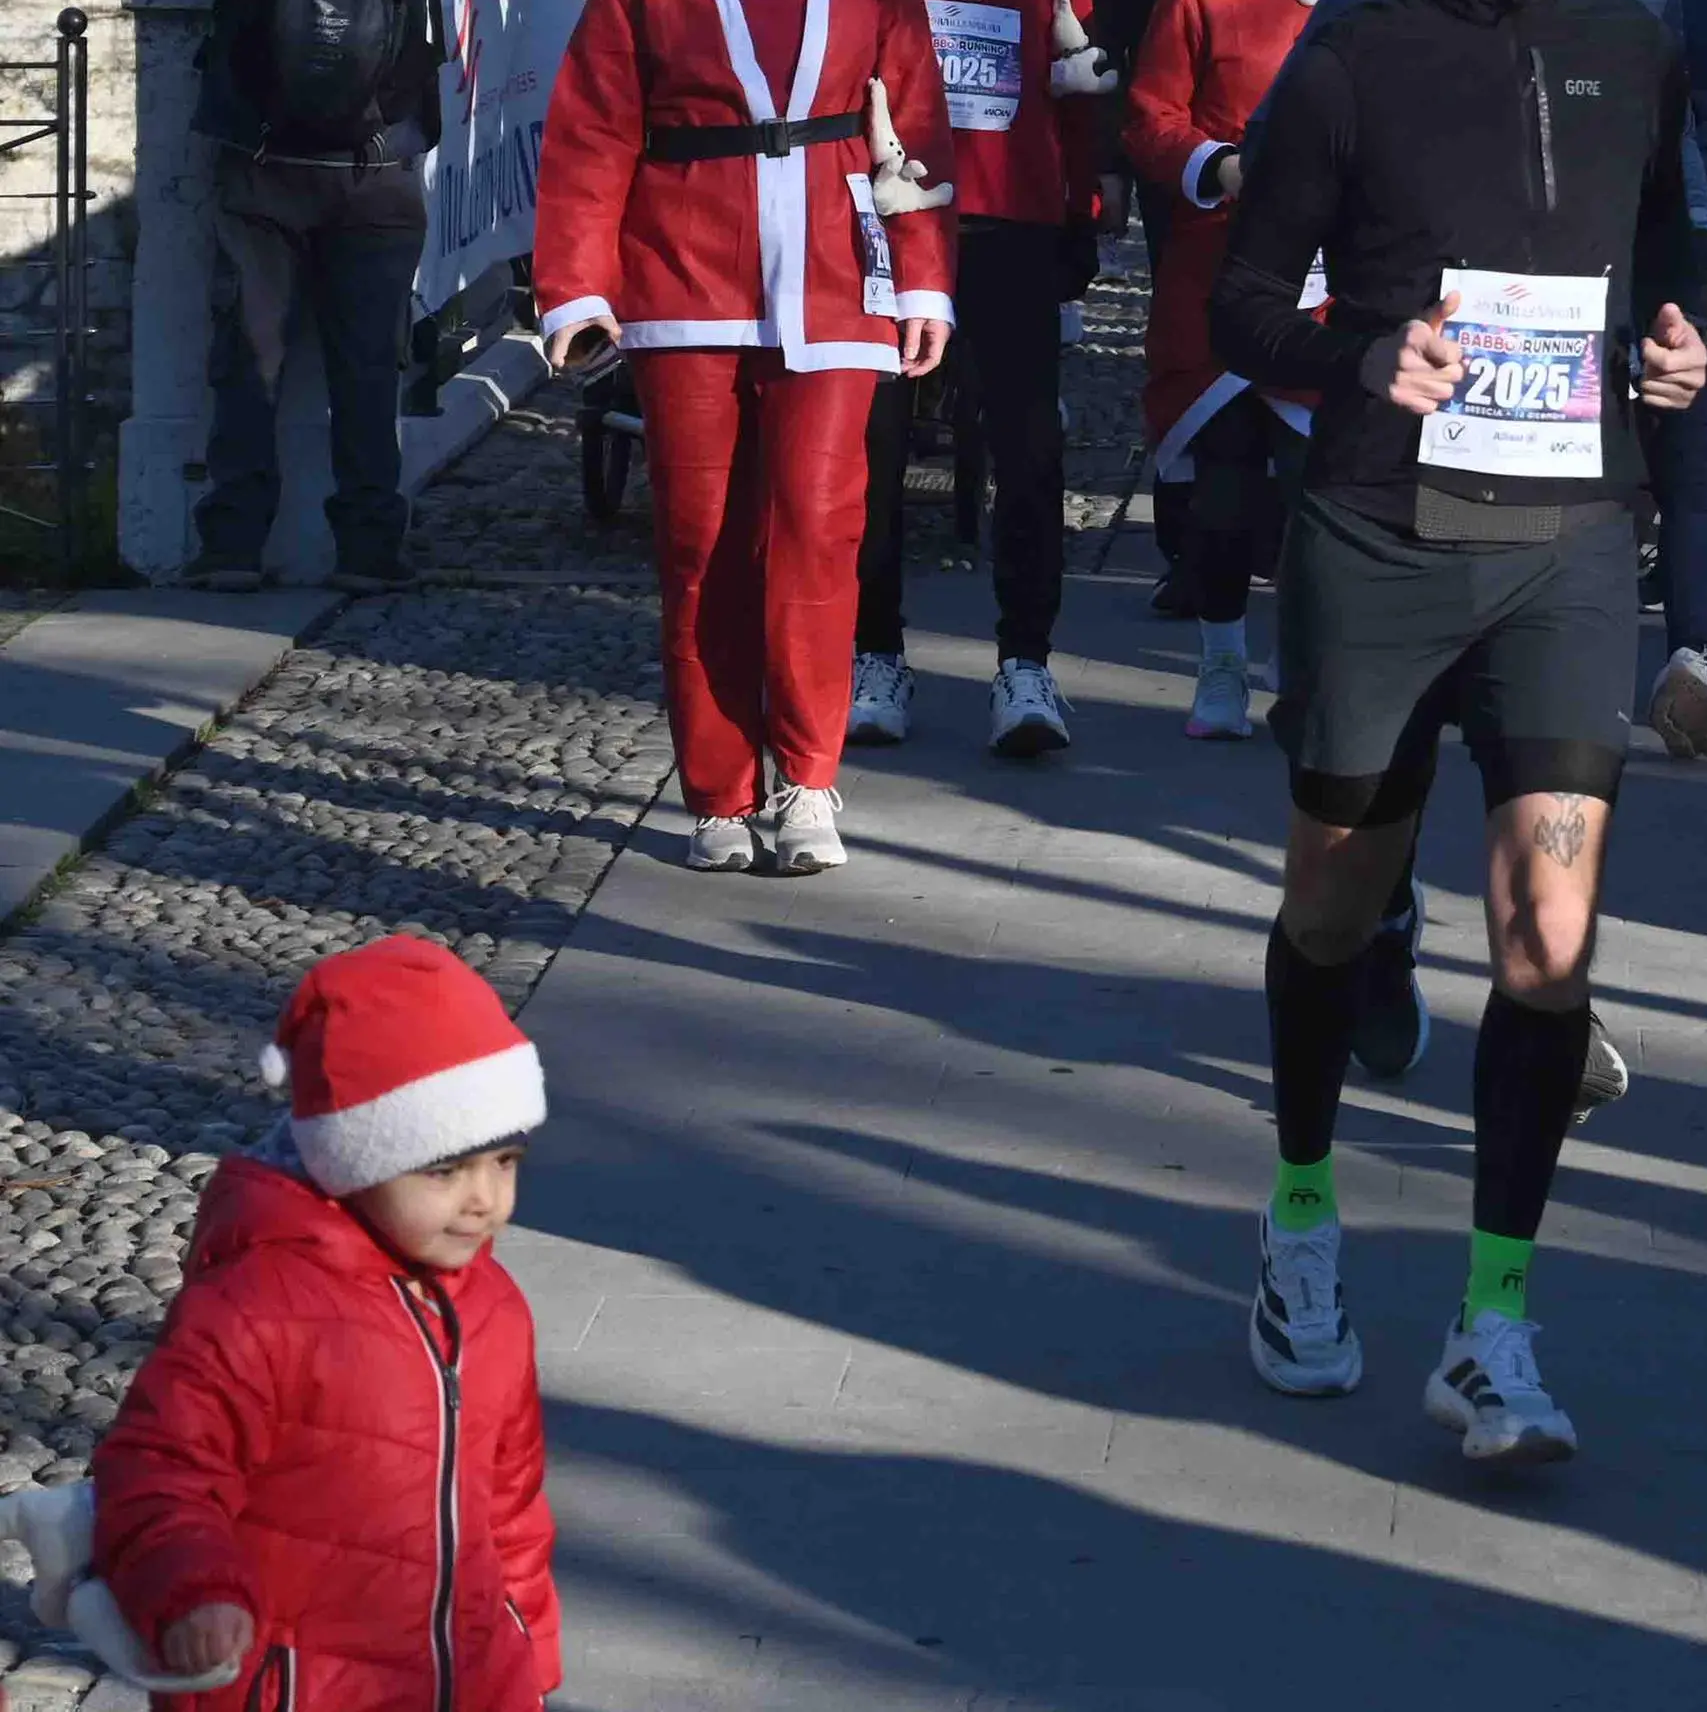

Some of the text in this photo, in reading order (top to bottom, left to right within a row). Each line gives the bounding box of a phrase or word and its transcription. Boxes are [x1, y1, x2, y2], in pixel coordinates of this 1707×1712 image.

[933, 37, 955, 49] BBO
[936, 55, 998, 88] 025
[1565, 79, 1602, 96] GORE
[1460, 332, 1584, 355] BABBO RUNNING
[1465, 358, 1572, 411] 2025
